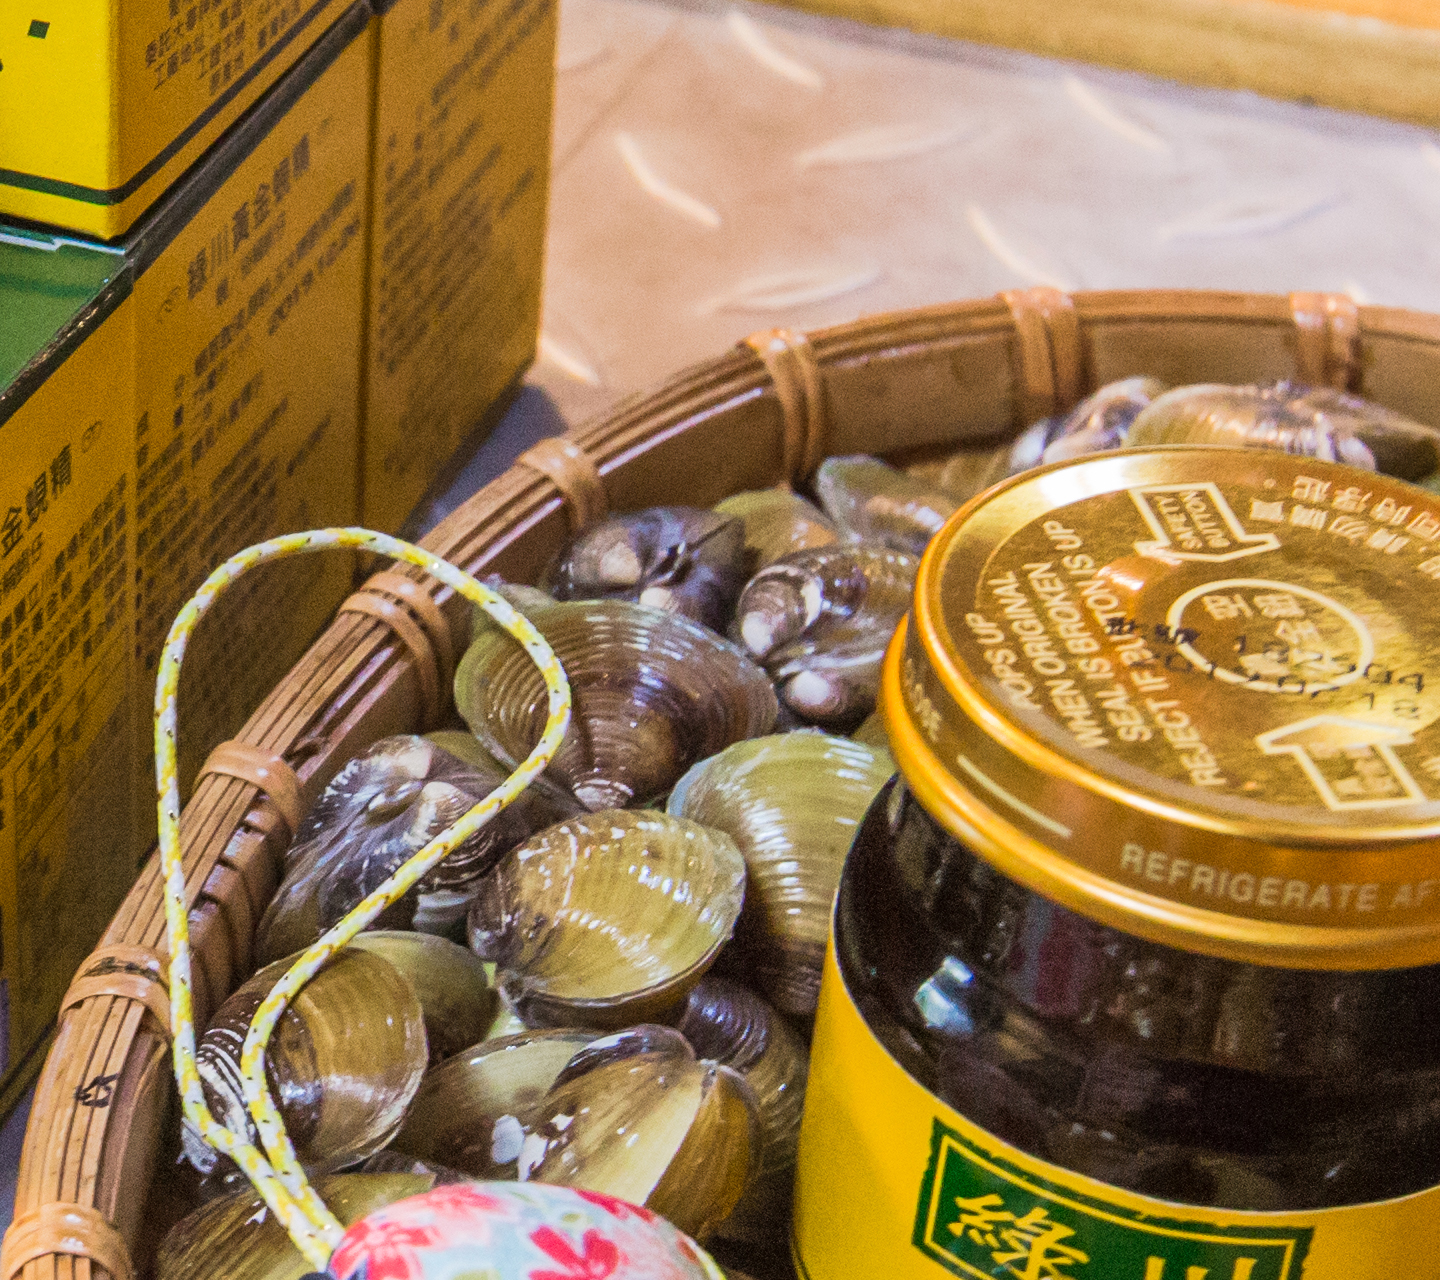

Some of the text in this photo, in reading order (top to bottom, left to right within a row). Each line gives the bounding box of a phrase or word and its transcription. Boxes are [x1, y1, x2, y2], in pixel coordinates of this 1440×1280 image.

[1033, 519, 1087, 550] UP
[1151, 494, 1206, 548] SAFETY
[1055, 553, 1102, 575] IS
[958, 611, 1007, 645] UP
[1016, 561, 1155, 742] SEAL IS BROKEN
[976, 570, 1111, 748] WHEN ORIGINAL
[1123, 669, 1170, 691] IF
[1143, 697, 1228, 786] REJECT
[1121, 842, 1378, 913] REFRIGERATE
